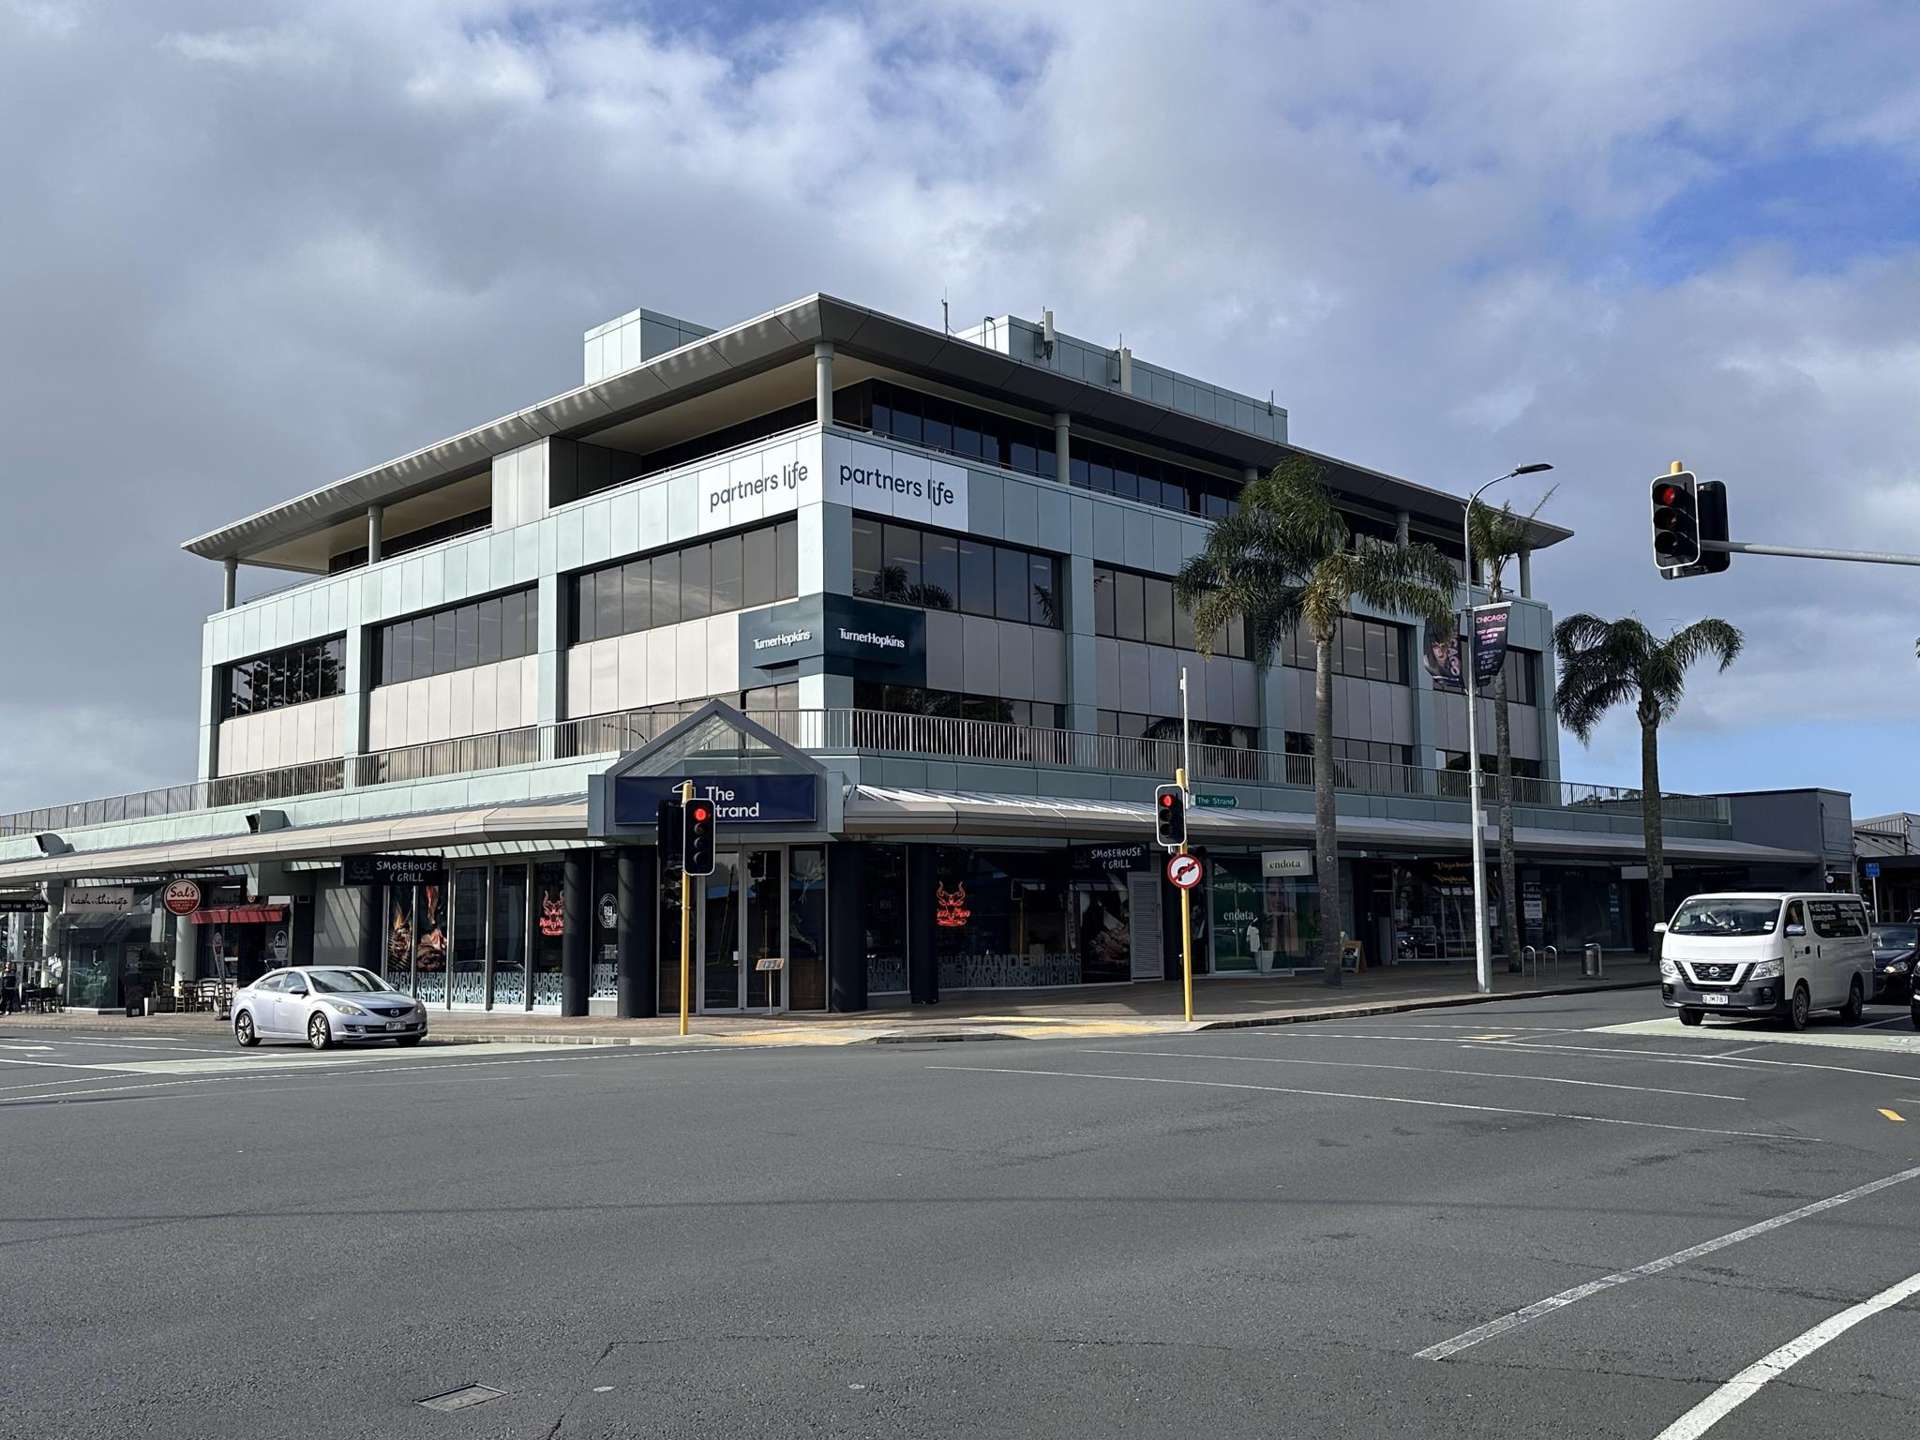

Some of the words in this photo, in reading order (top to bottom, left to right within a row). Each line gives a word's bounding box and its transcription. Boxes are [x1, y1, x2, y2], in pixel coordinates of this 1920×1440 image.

[710, 473, 778, 512] partners
[783, 461, 808, 490] life
[839, 464, 922, 497] partners
[927, 479, 954, 506] life
[1475, 613, 1508, 624] CHICAGO
[753, 629, 811, 650] TurnerHopkins
[838, 628, 905, 648] TurnerHopkins
[705, 786, 735, 801] The
[1213, 797, 1235, 806] Strand
[715, 802, 760, 817] trand
[1091, 846, 1142, 859] SMOKEHOUSE
[376, 860, 438, 871] SMOKEHOUSE
[1108, 859, 1132, 870] GRILL
[1269, 859, 1302, 870] endota
[397, 872, 425, 882] GRILL
[170, 886, 196, 898] Sal's
[1223, 910, 1255, 921] endota
